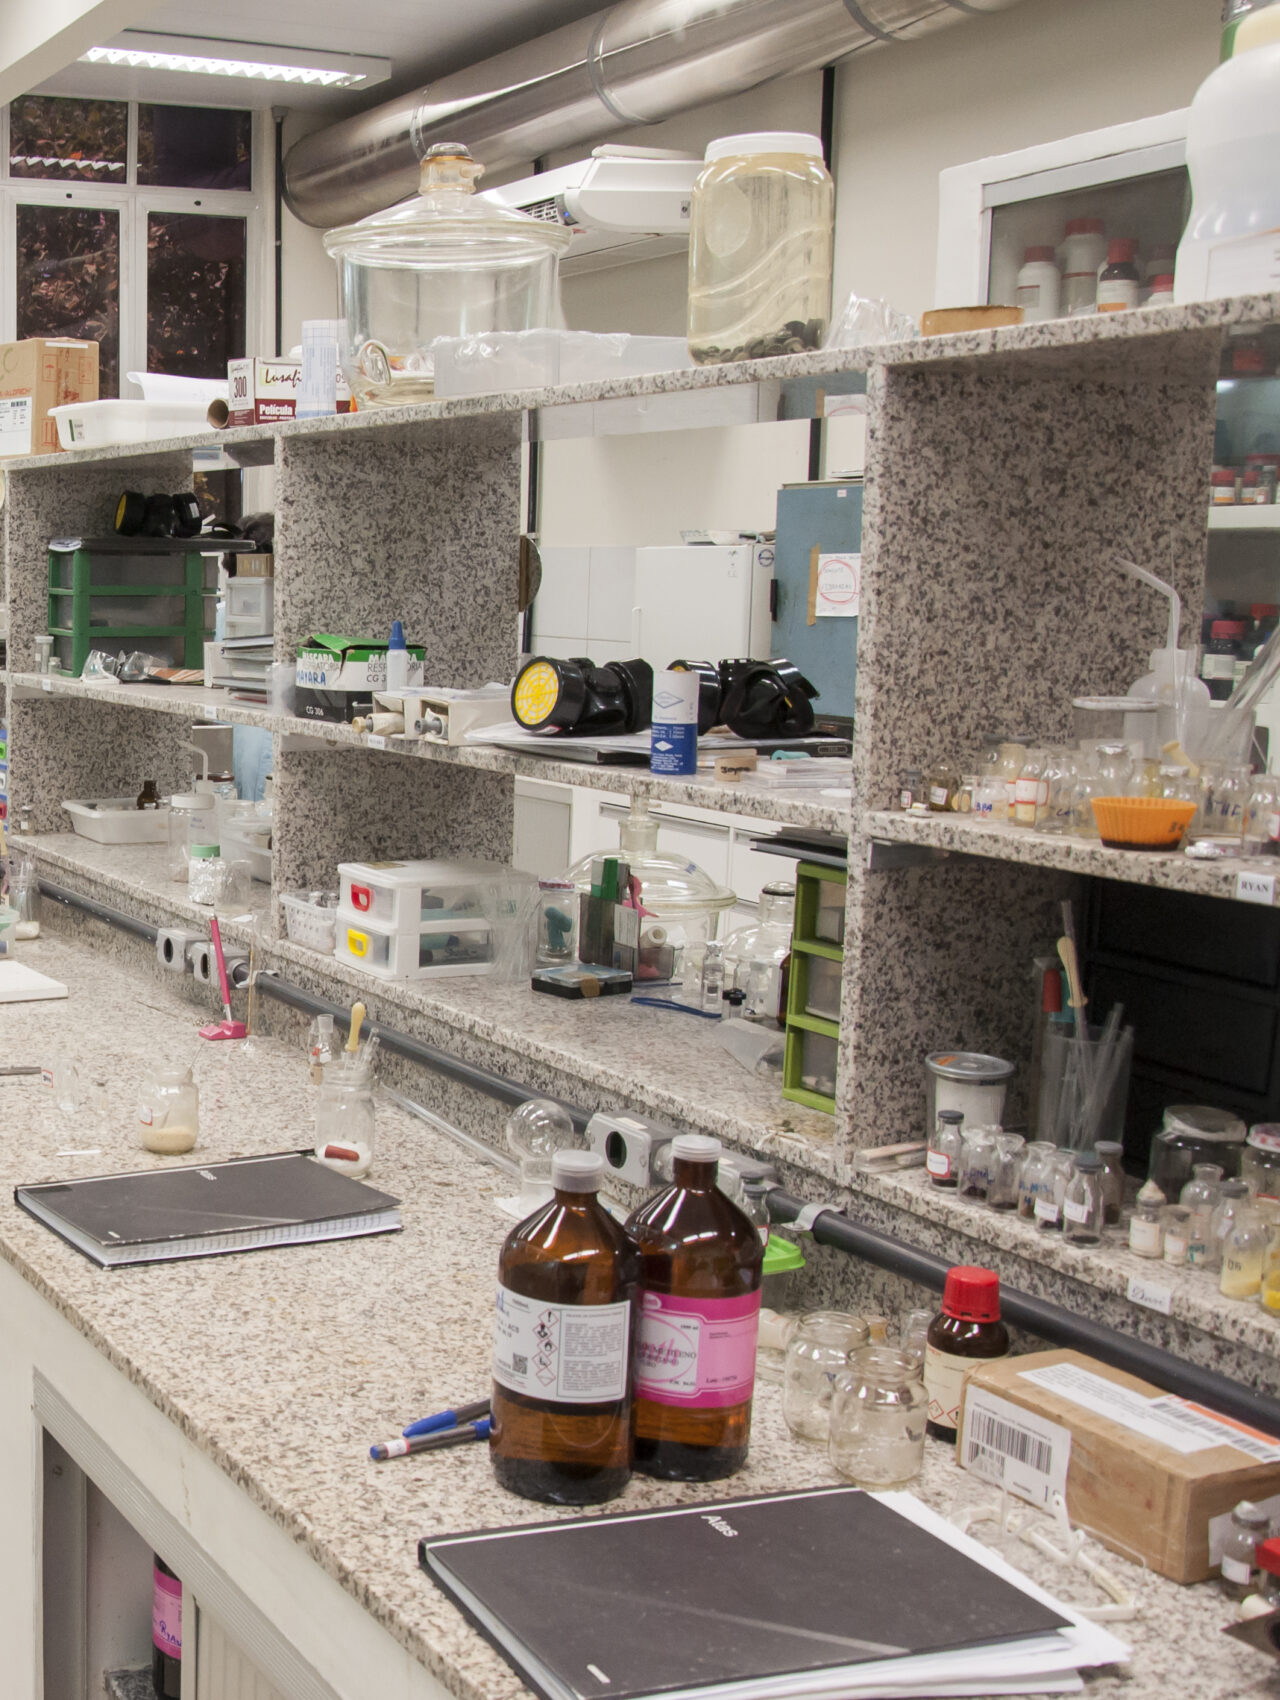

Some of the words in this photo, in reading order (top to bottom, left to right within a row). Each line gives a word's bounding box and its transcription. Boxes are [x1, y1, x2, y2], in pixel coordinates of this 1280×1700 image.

[233, 376, 247, 398] 300
[259, 404, 293, 416] Película
[366, 674, 379, 683] CG
[306, 706, 314, 714] CG
[315, 707, 324, 716] 306
[1241, 880, 1269, 892] RYAN
